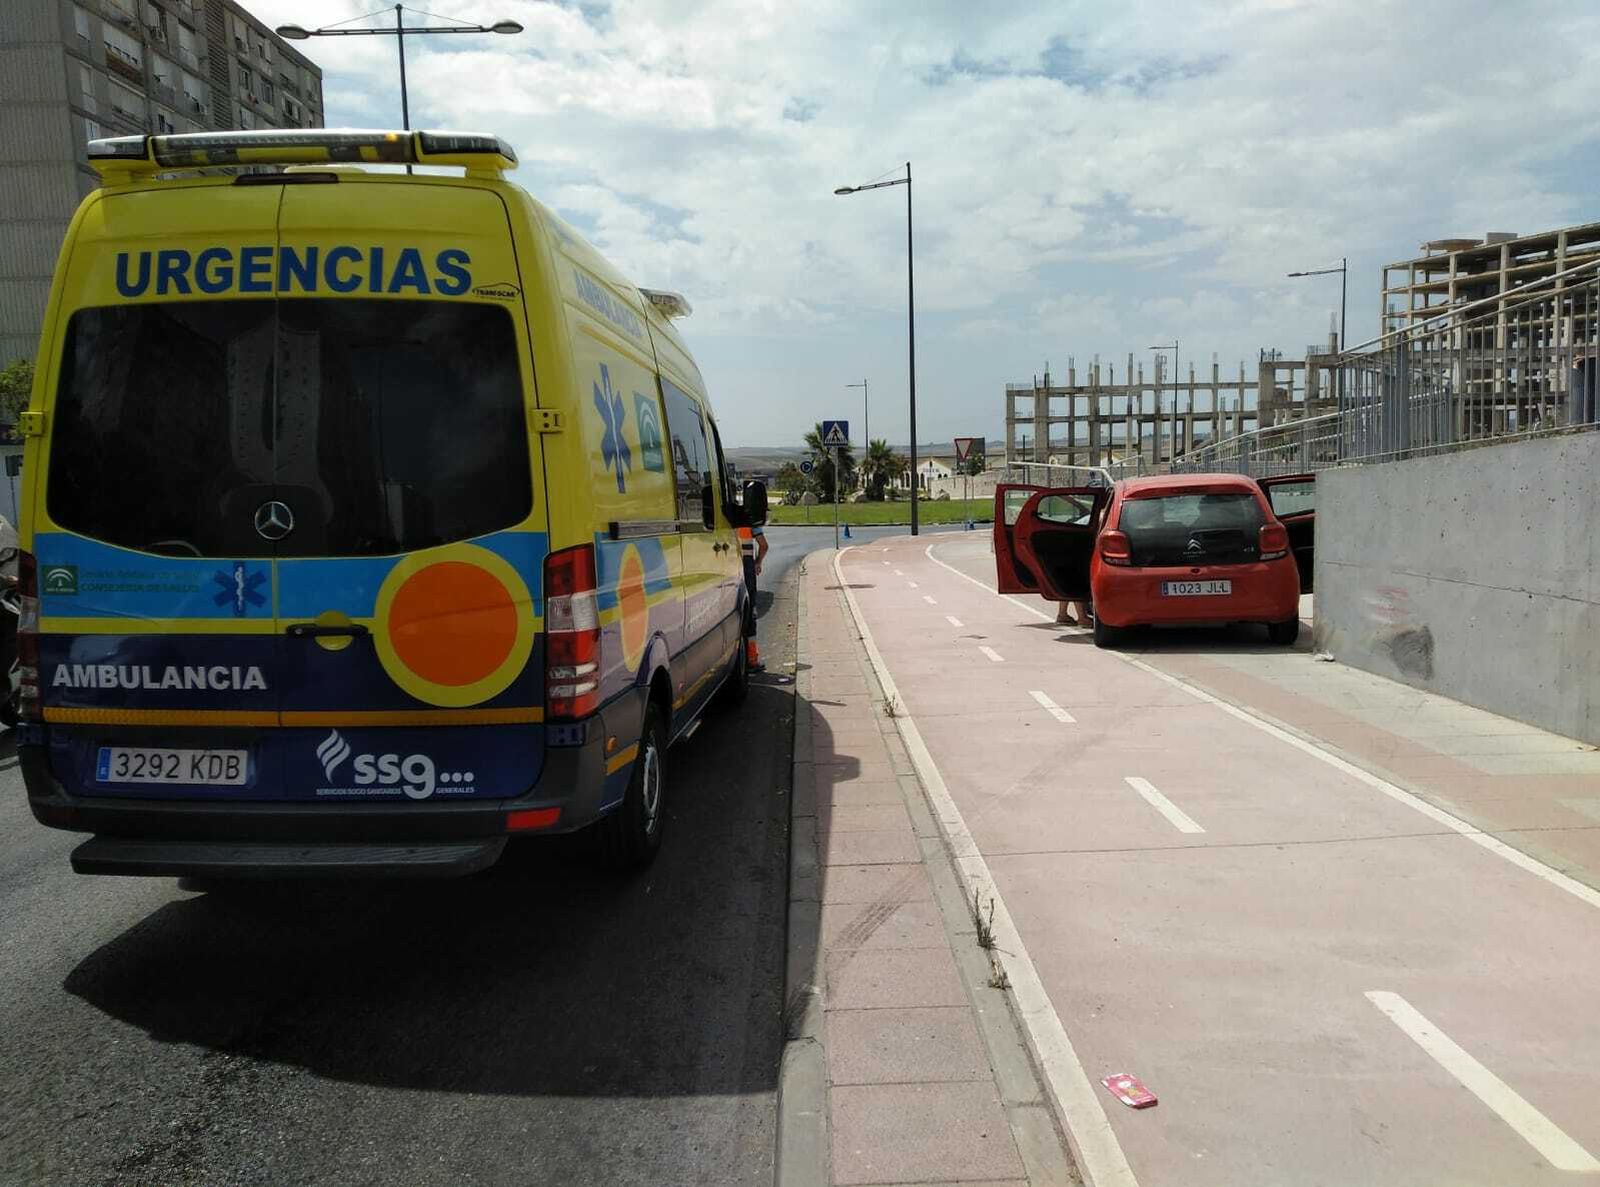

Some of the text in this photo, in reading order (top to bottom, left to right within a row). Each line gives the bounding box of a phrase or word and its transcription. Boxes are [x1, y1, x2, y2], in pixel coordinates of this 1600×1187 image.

[115, 246, 472, 297] URGENCIAS
[52, 664, 267, 690] AMBULANCIA
[115, 753, 240, 779] 3292 KDB
